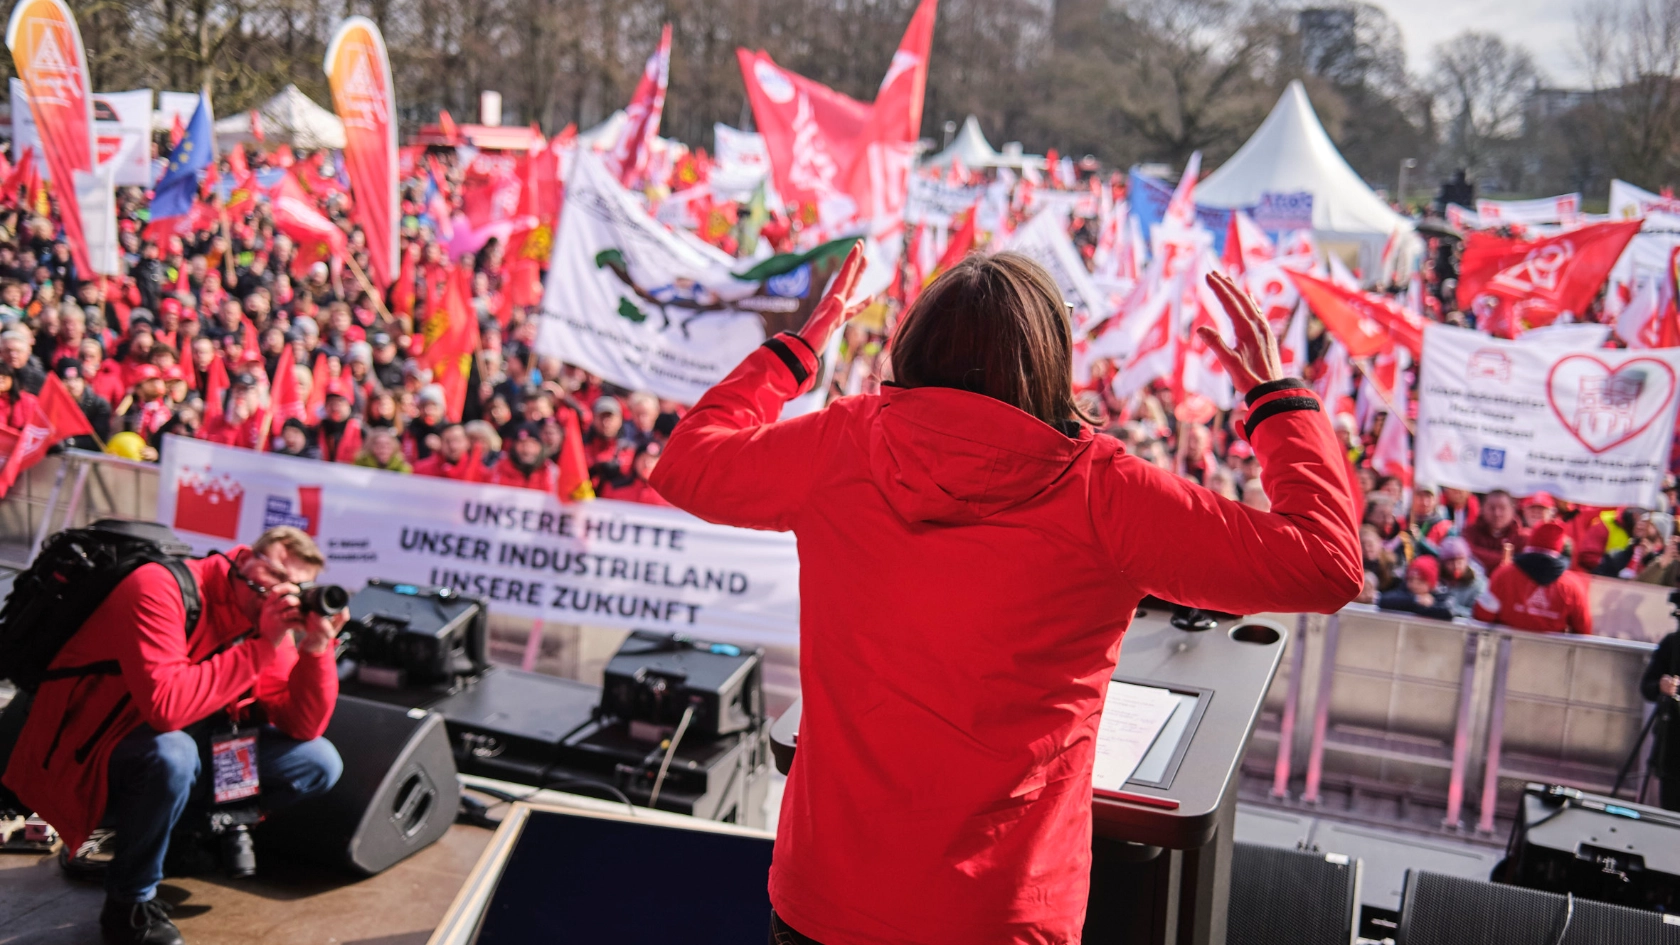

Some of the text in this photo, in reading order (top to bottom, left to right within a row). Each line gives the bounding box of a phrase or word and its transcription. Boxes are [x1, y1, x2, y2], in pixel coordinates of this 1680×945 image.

[463, 500, 686, 551] UNSERE HÜTTE
[399, 525, 748, 595] UNSER INDUSTRIELAND
[430, 567, 701, 624] UNSERE ZUKUNFT
